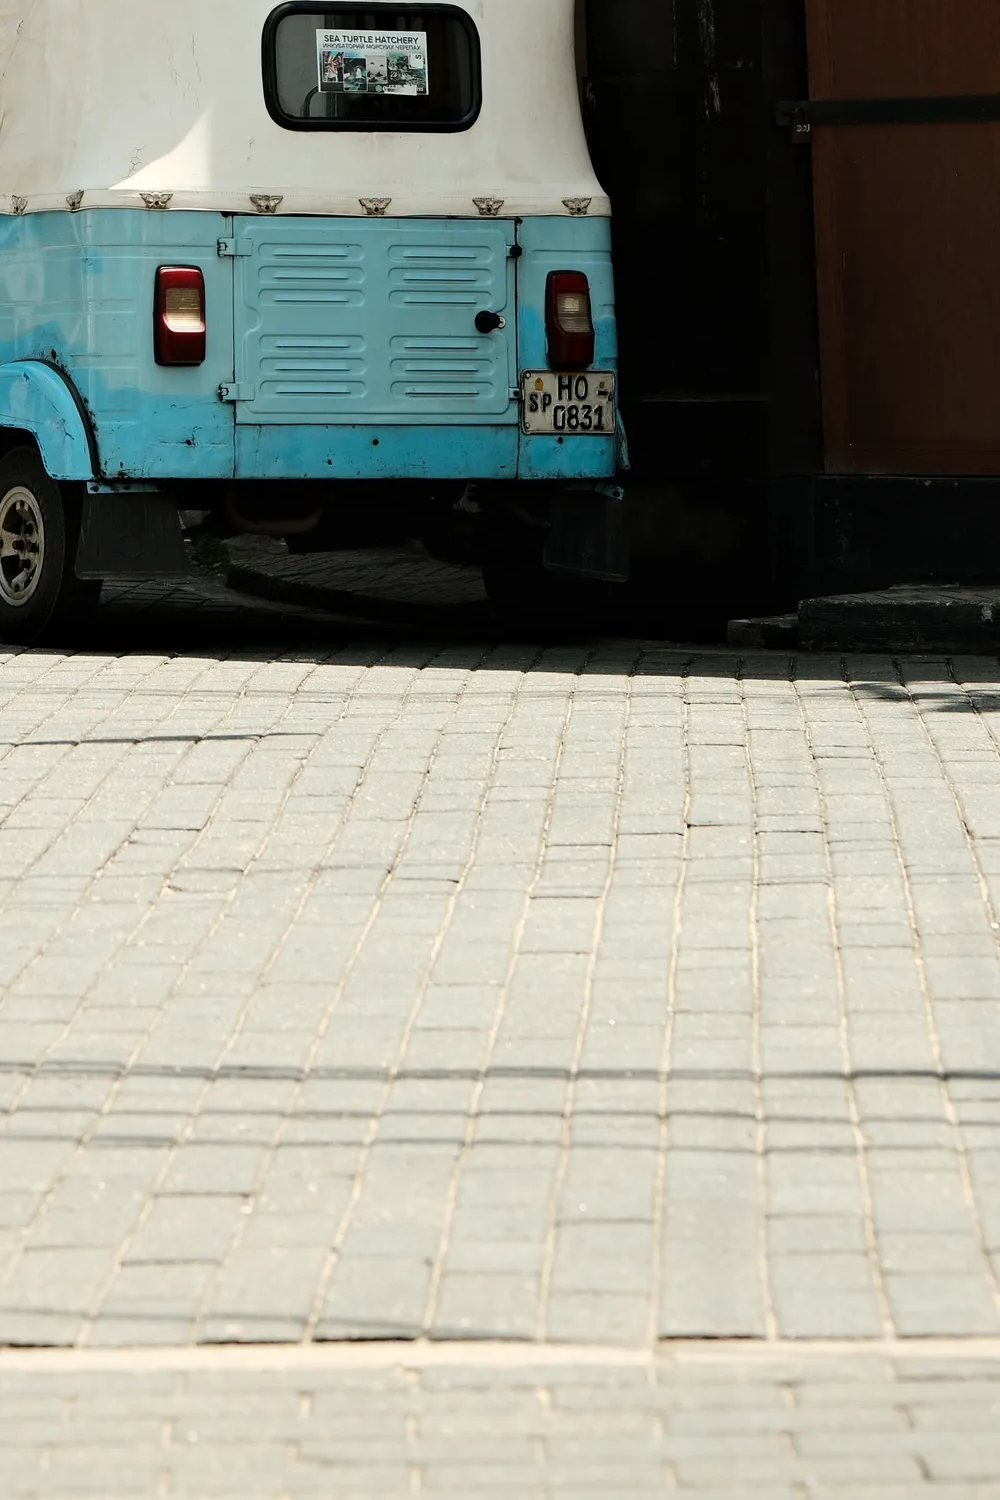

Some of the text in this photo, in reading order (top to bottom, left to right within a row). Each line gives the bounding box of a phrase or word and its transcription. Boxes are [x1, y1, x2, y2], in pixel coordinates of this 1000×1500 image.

[324, 34, 419, 45] SEA TURTLE HATCHERY
[529, 391, 552, 413] SP
[553, 404, 605, 430] 0831
